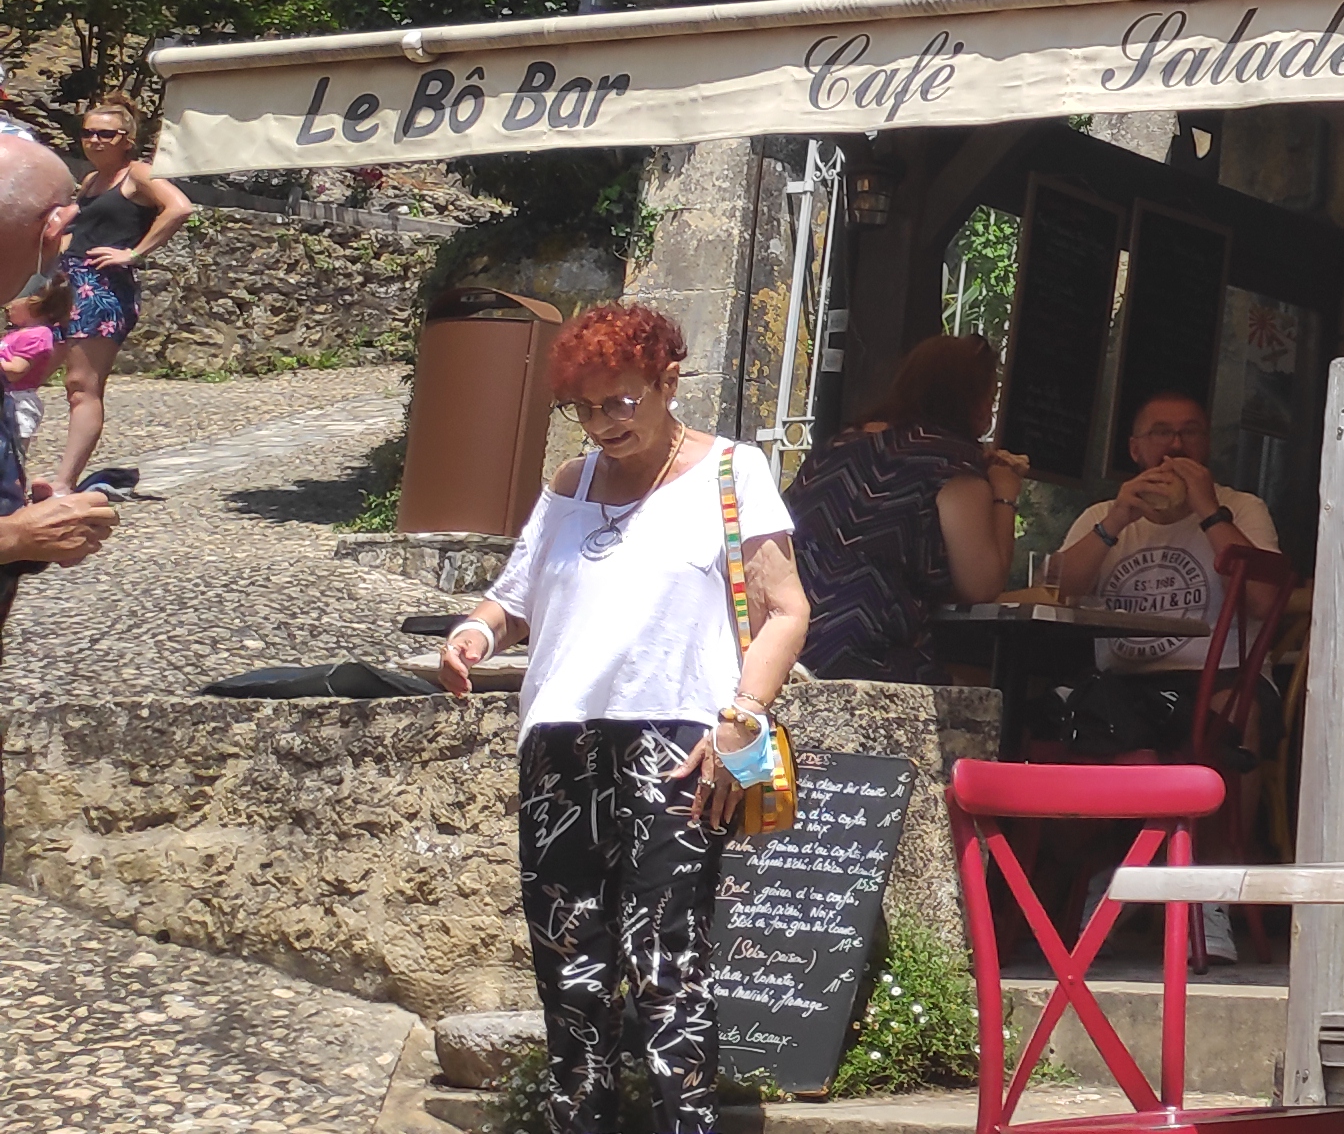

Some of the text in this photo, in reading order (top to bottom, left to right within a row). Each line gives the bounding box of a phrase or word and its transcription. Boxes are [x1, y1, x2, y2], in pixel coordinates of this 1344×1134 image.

[803, 30, 966, 123] Café
[296, 61, 631, 147] Le Bô Bar
[1183, 588, 1202, 606] CO
[1148, 637, 1184, 656] QUAL
